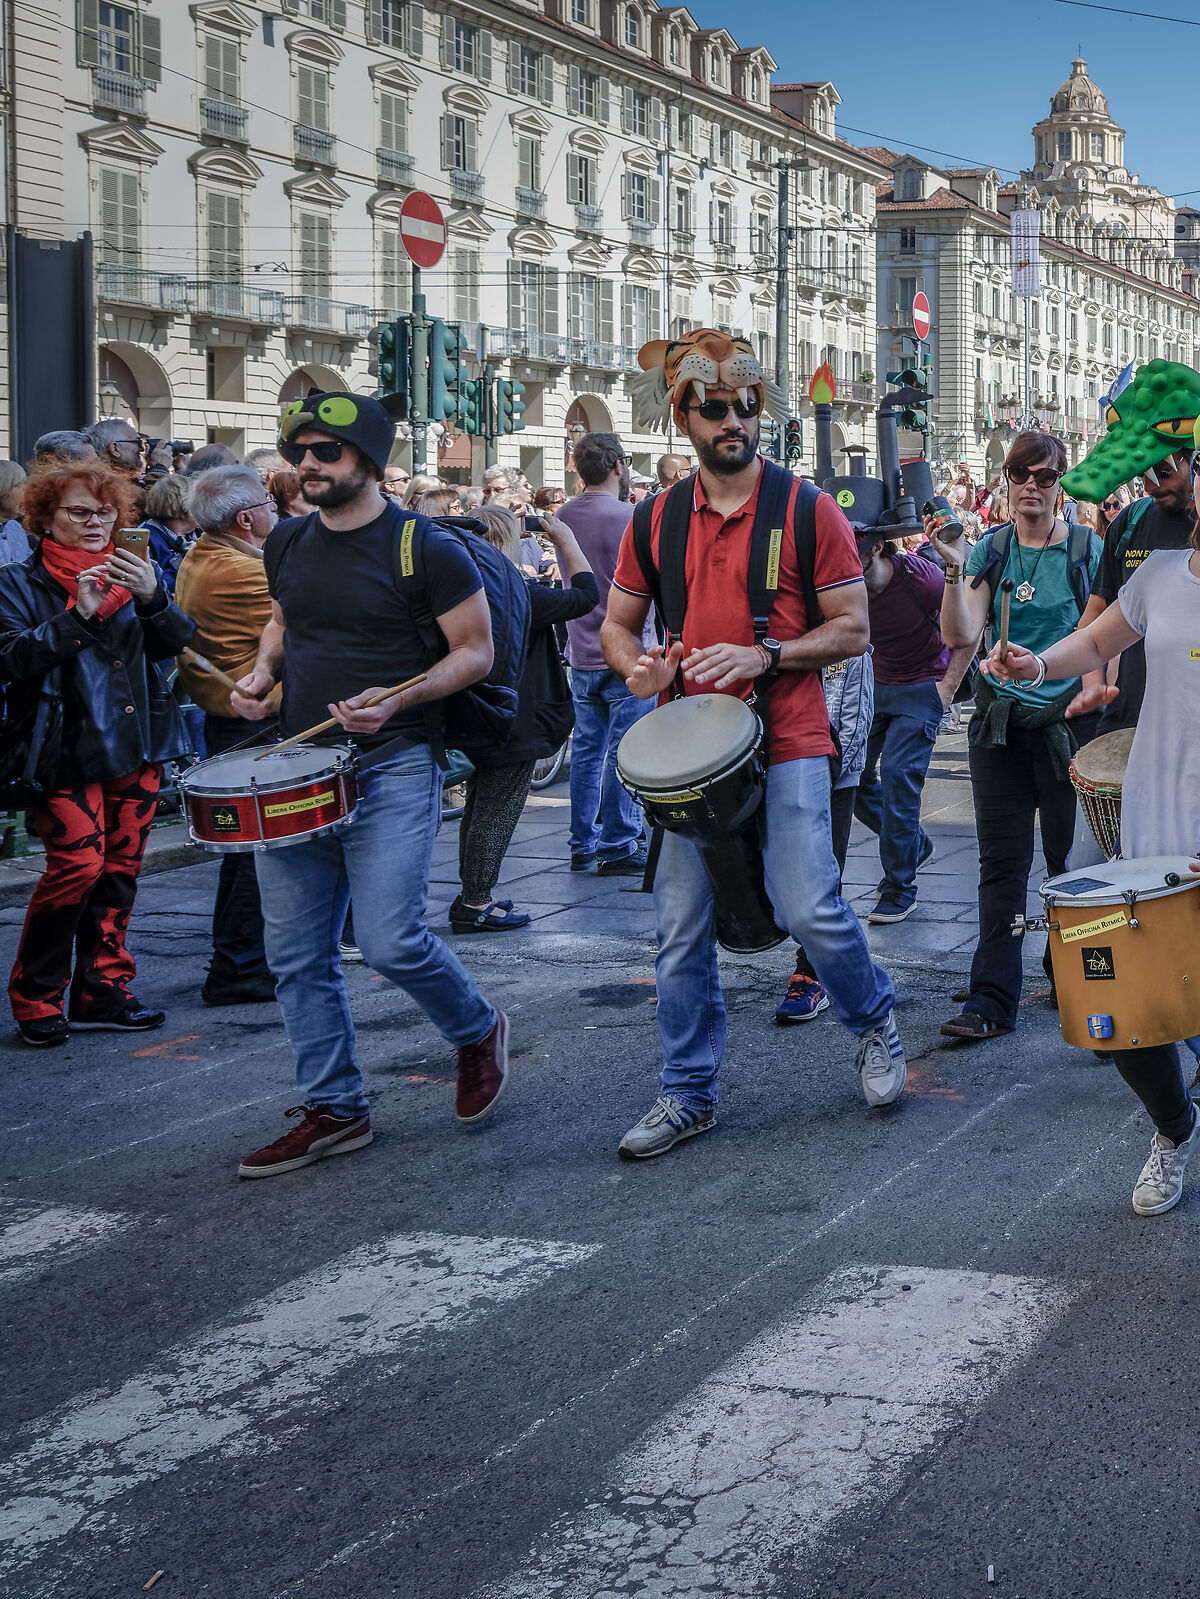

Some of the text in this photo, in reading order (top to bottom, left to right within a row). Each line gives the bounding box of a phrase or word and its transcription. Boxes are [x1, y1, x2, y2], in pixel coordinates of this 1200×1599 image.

[1125, 550, 1143, 558] NON
[267, 794, 334, 816] LIBERA OFFICINA RITMICA
[1062, 916, 1126, 940] LIBERA OFFICINA RITMICA
